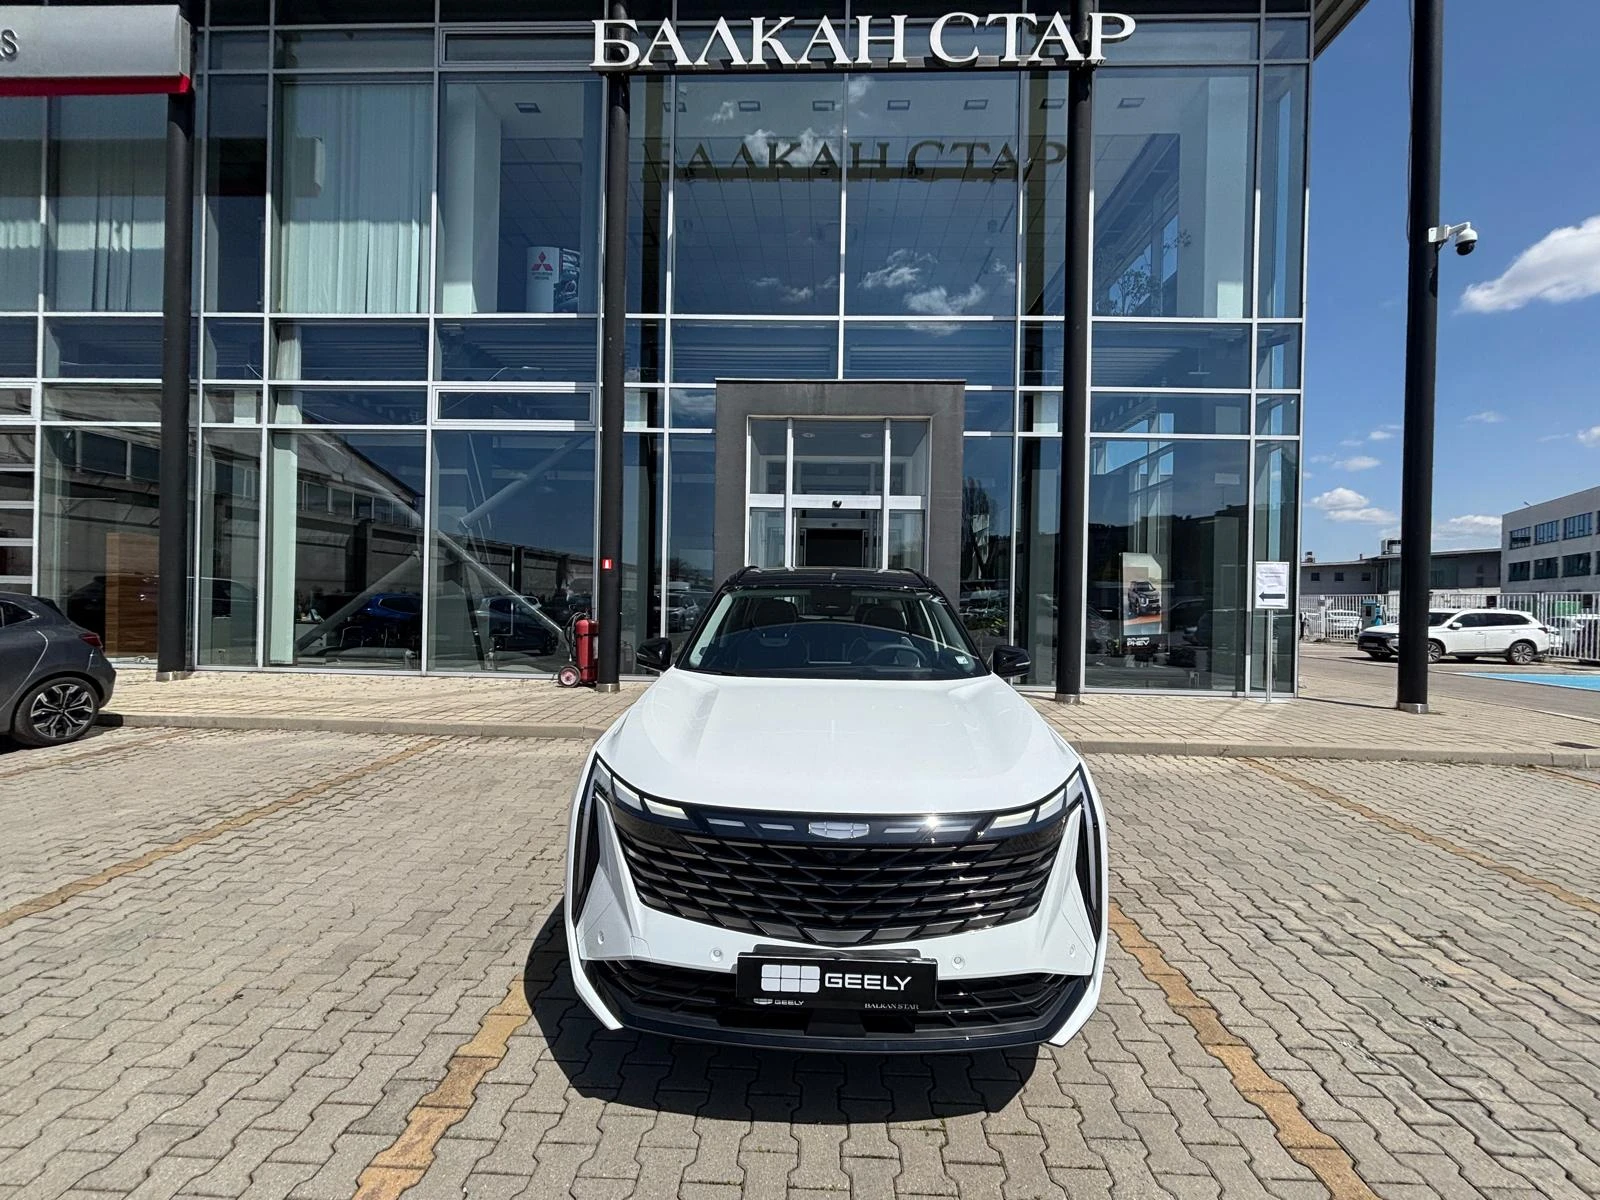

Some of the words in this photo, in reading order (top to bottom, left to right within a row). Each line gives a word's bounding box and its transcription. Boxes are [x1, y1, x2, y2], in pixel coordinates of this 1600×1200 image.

[589, 14, 909, 68] БАЛКАН
[929, 11, 1137, 64] СТАР
[824, 973, 912, 991] GEELY
